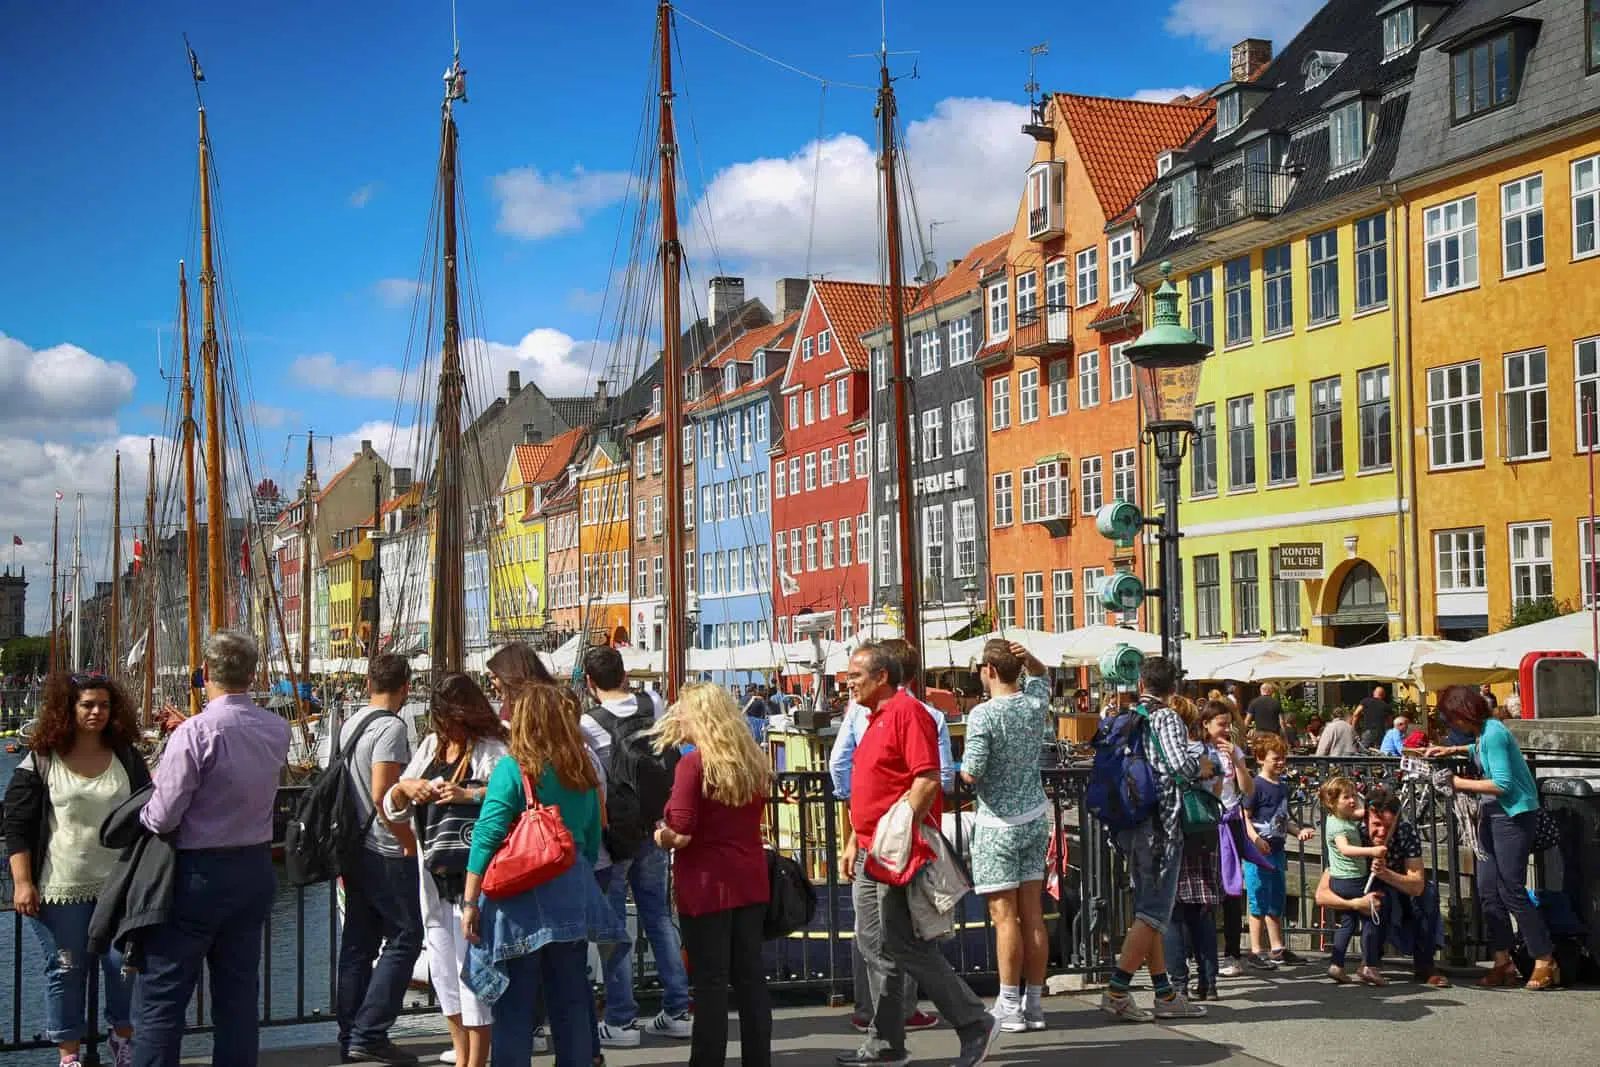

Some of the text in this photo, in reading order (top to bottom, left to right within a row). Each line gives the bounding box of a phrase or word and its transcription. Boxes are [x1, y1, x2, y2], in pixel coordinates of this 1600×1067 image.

[1281, 547, 1321, 556] KONTOR
[1282, 557, 1318, 566] TIL LEJE
